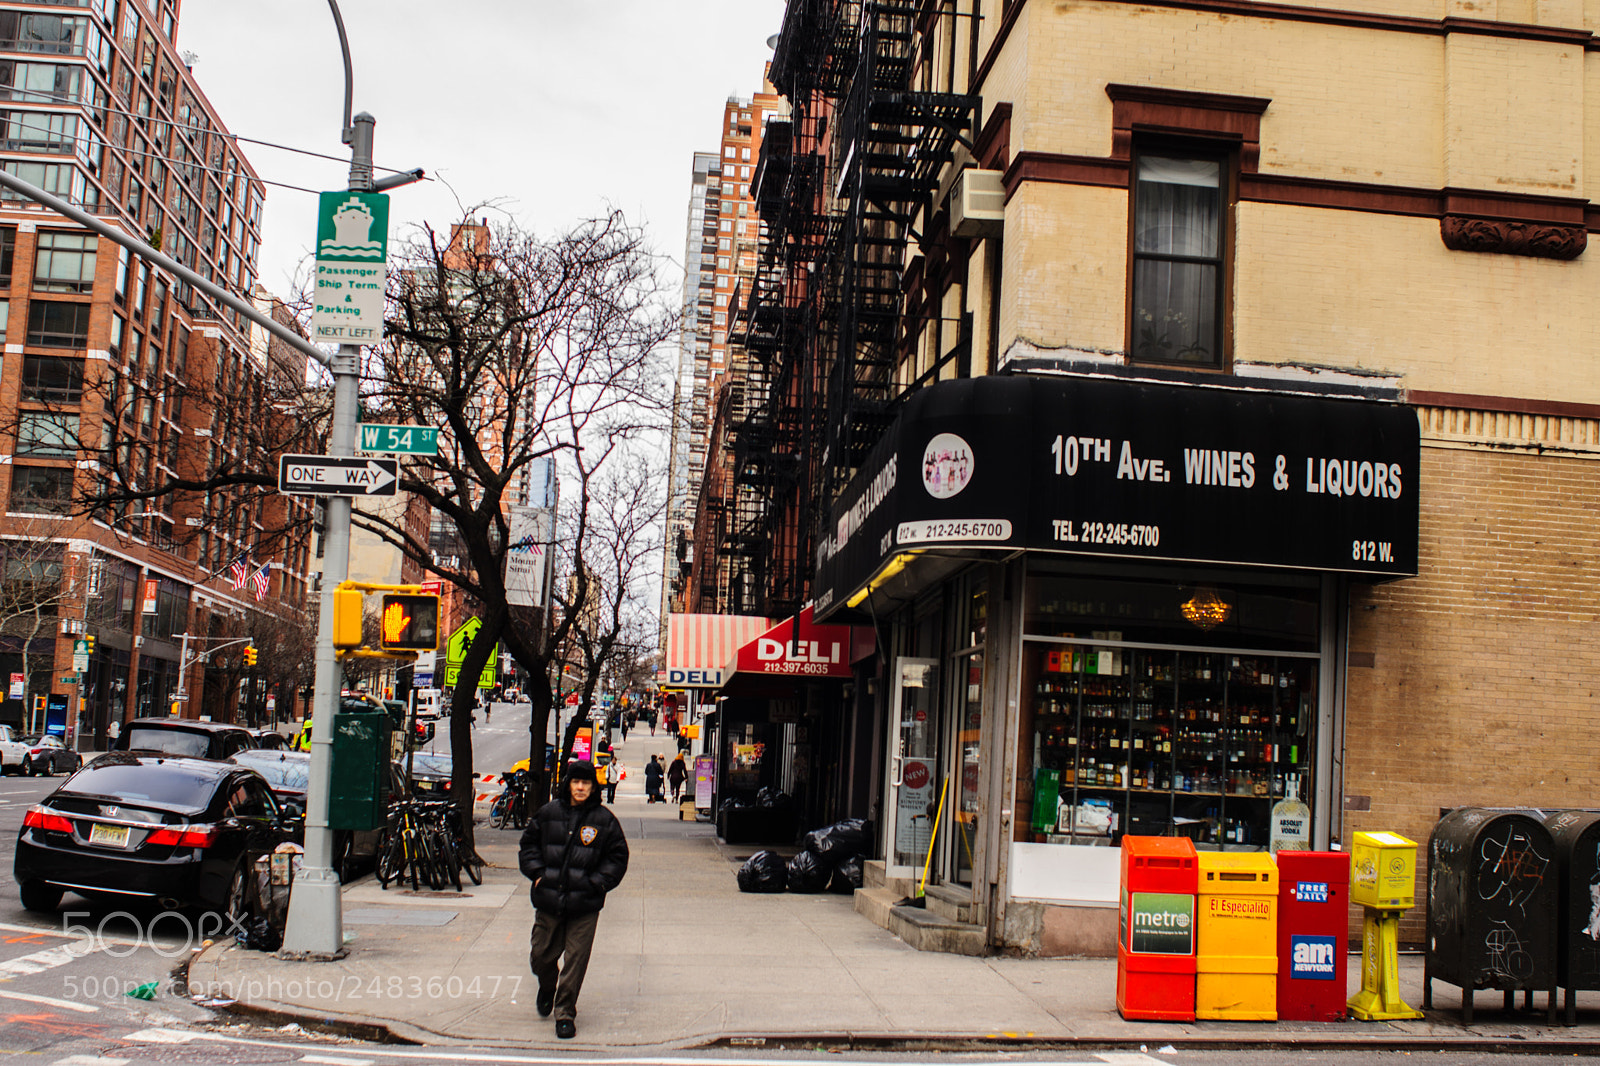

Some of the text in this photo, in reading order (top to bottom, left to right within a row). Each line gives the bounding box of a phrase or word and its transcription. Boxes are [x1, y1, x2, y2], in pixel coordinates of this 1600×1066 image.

[318, 266, 378, 277] Passenger
[318, 280, 380, 289] Ship Term.
[344, 294, 352, 302] &
[316, 305, 361, 316] Parking
[317, 326, 374, 338] NEXT LEFT
[364, 427, 433, 449] W 54 ST
[1052, 435, 1111, 476] 10TH
[1184, 448, 1255, 489] WINES
[1273, 454, 1289, 491] &
[1306, 457, 1402, 499] LIQUORS
[291, 467, 382, 484] ONE WAY
[926, 523, 1003, 538] 212-245-6700
[1052, 519, 1160, 546] TEL. 212-245-6700
[1352, 540, 1394, 562] 812 W.
[511, 556, 536, 566] Mount
[757, 638, 841, 664] DELI
[764, 662, 829, 674] 212-397-6035
[669, 670, 721, 684] DELI
[905, 768, 925, 781] NEW
[1280, 819, 1303, 827] ABSOLUT
[1299, 884, 1326, 892] FREE
[1297, 892, 1328, 901] DAILY
[1211, 899, 1269, 914] El Especialito
[1135, 910, 1190, 928] metro
[1293, 943, 1333, 964] am
